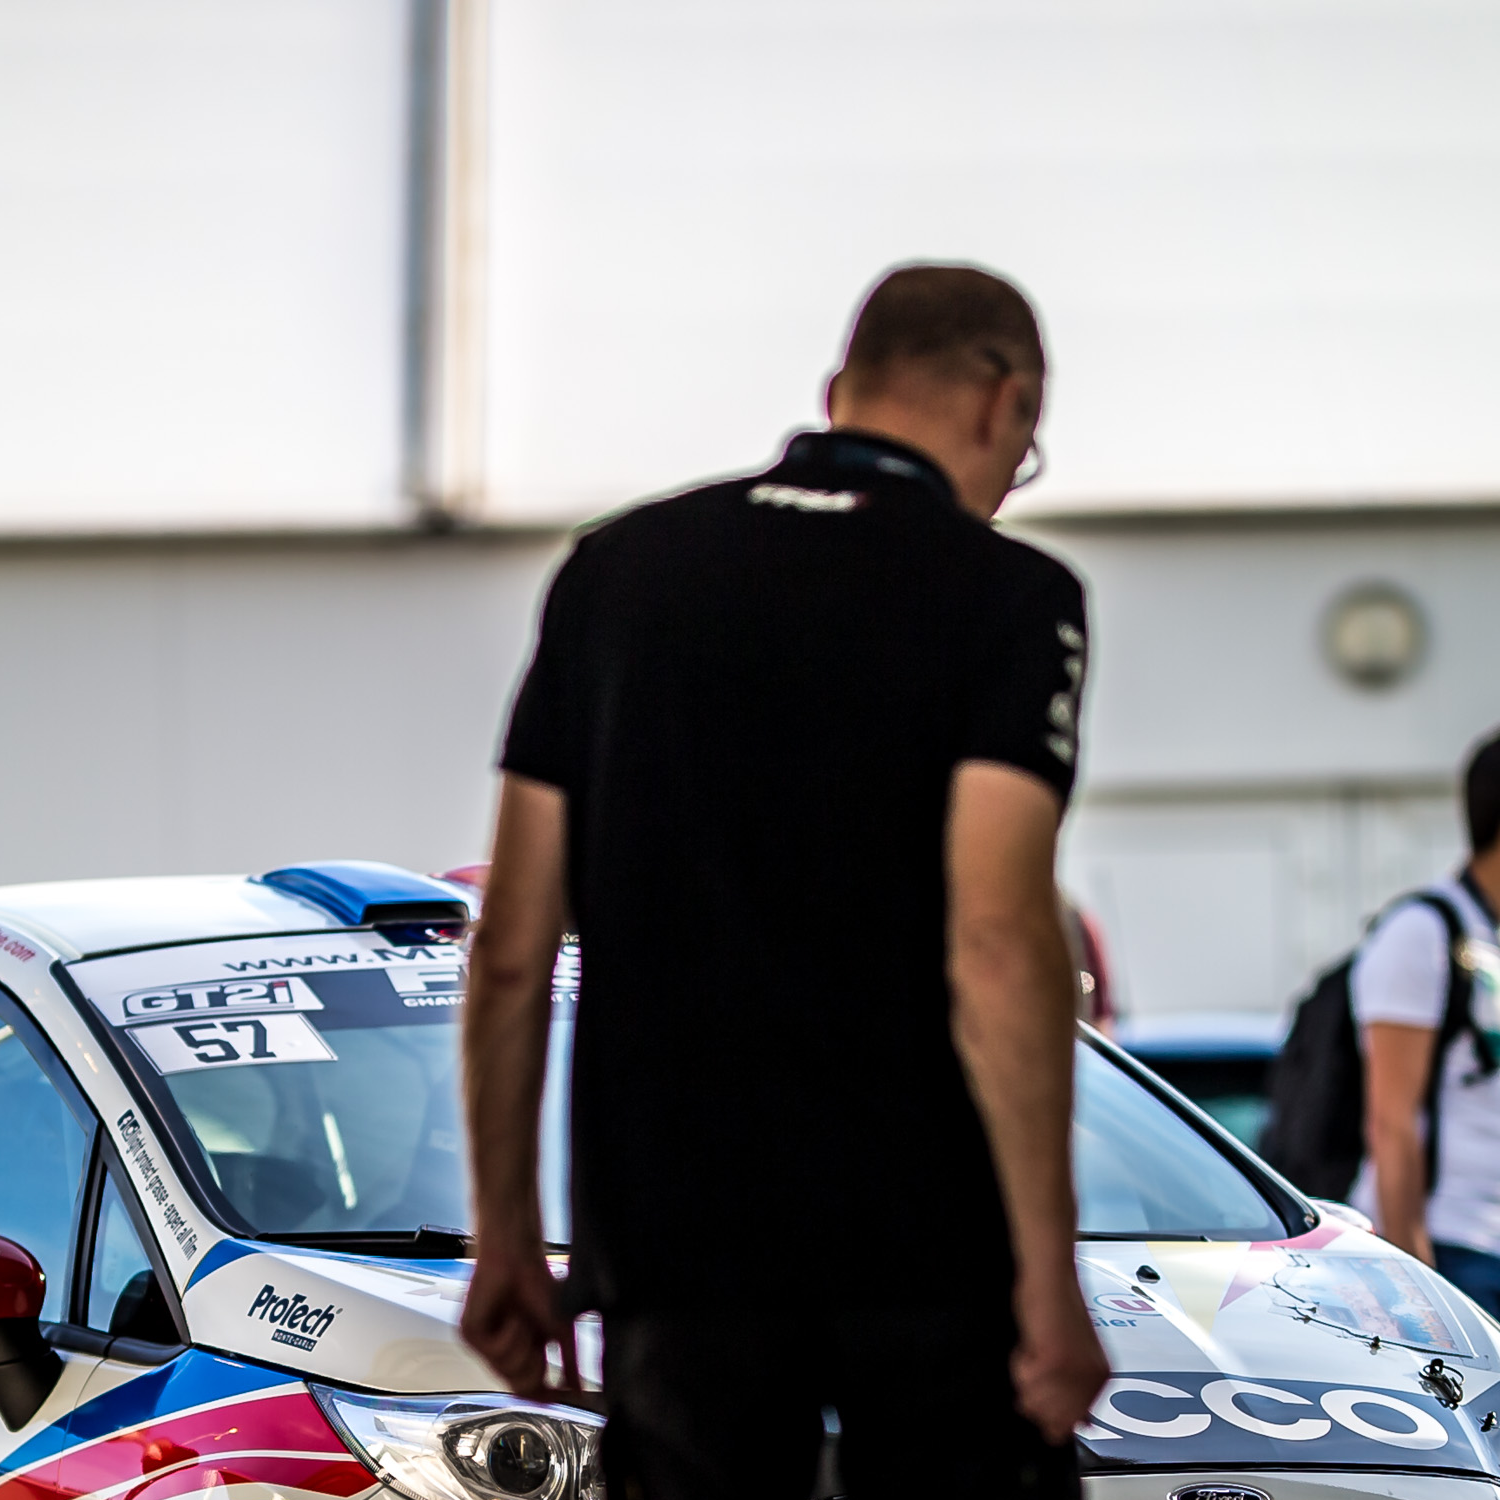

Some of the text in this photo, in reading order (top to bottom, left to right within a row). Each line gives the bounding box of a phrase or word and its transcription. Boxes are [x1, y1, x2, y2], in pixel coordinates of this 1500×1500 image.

[222, 946, 468, 973] www.M-
[125, 979, 293, 1016] GT2i
[403, 994, 467, 1008] CHAM
[173, 1020, 277, 1063] 57
[126, 1130, 147, 1155] light
[132, 1149, 160, 1183] protect
[145, 1172, 170, 1206] grasse
[163, 1203, 189, 1235] expert
[176, 1227, 194, 1247] all
[182, 1233, 198, 1261] film
[247, 1284, 335, 1338] ProTech
[1075, 1378, 1449, 1450] CCO
